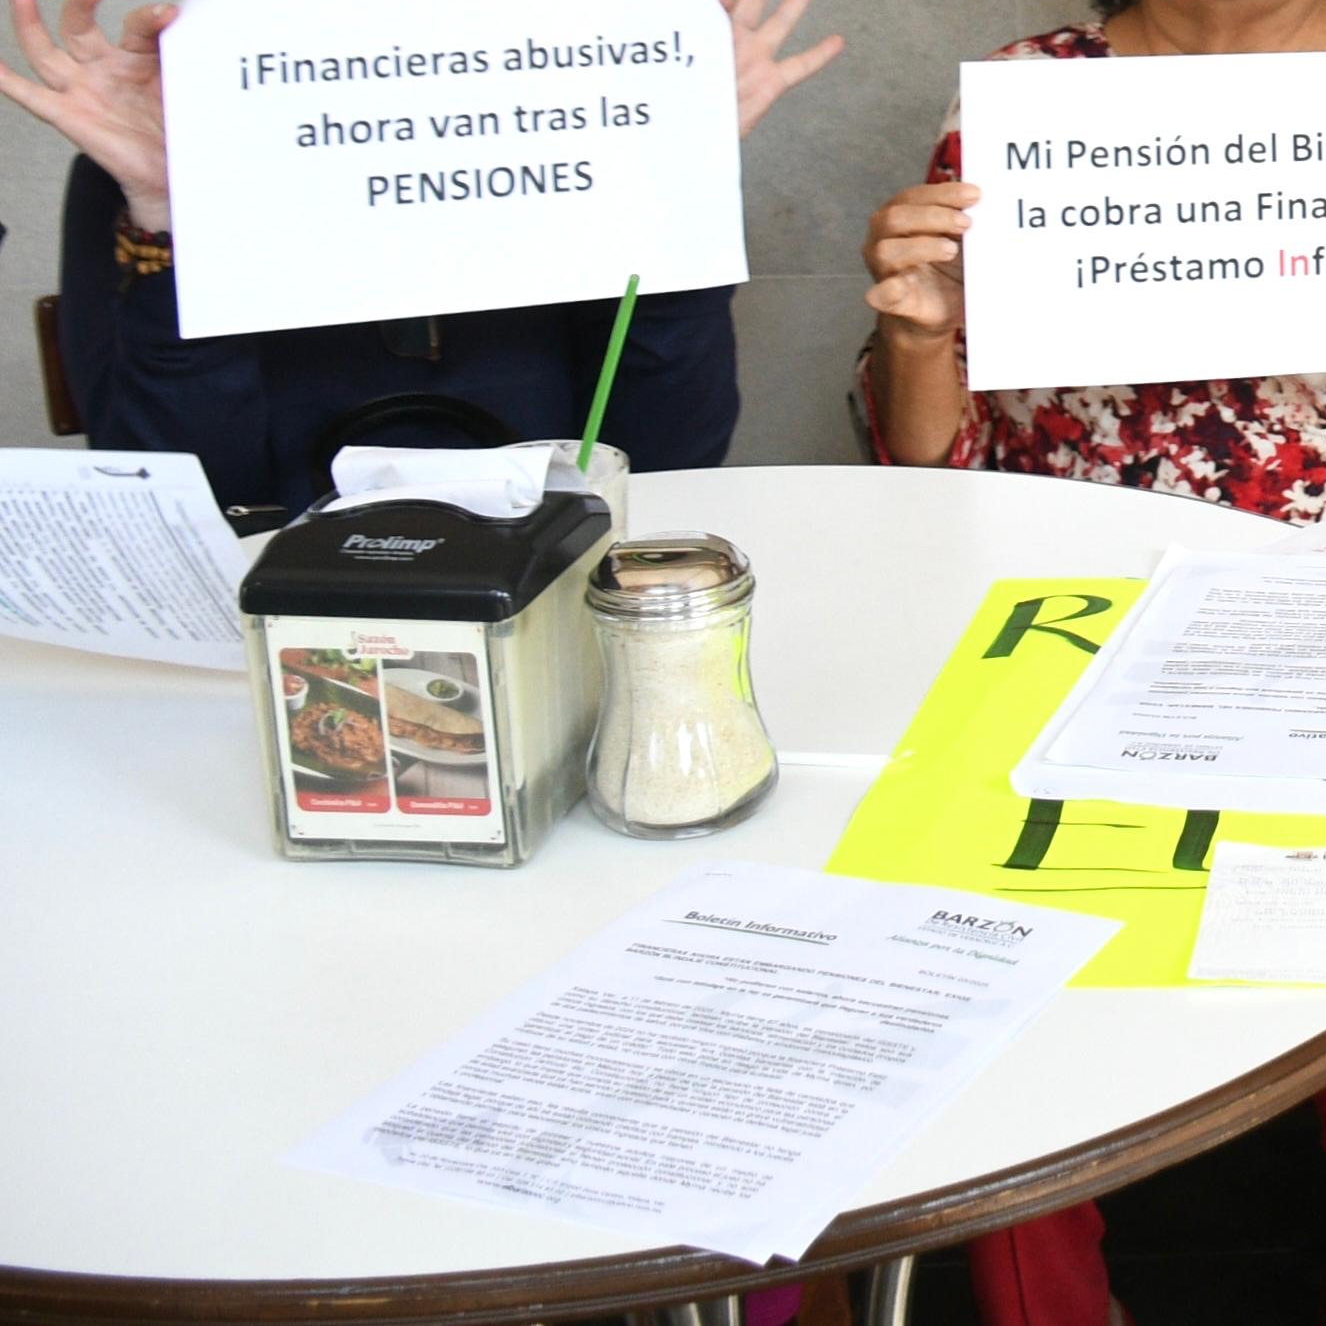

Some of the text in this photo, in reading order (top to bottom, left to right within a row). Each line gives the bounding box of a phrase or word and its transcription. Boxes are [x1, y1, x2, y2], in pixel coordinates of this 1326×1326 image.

[240, 30, 694, 91] ¡Financieras abusivas!,
[297, 96, 650, 148] ahora van tras las
[1006, 139, 1052, 171] Mi
[1067, 135, 1210, 169] Pensión
[1224, 132, 1277, 164] del
[367, 160, 593, 207] PENSIONES
[1017, 198, 1046, 229] la
[1060, 195, 1162, 228] cobra
[1176, 200, 1242, 224] una
[1076, 252, 1265, 289] ¡Préstamo
[342, 534, 438, 553] Prolimp
[744, 920, 838, 942] Informativo
